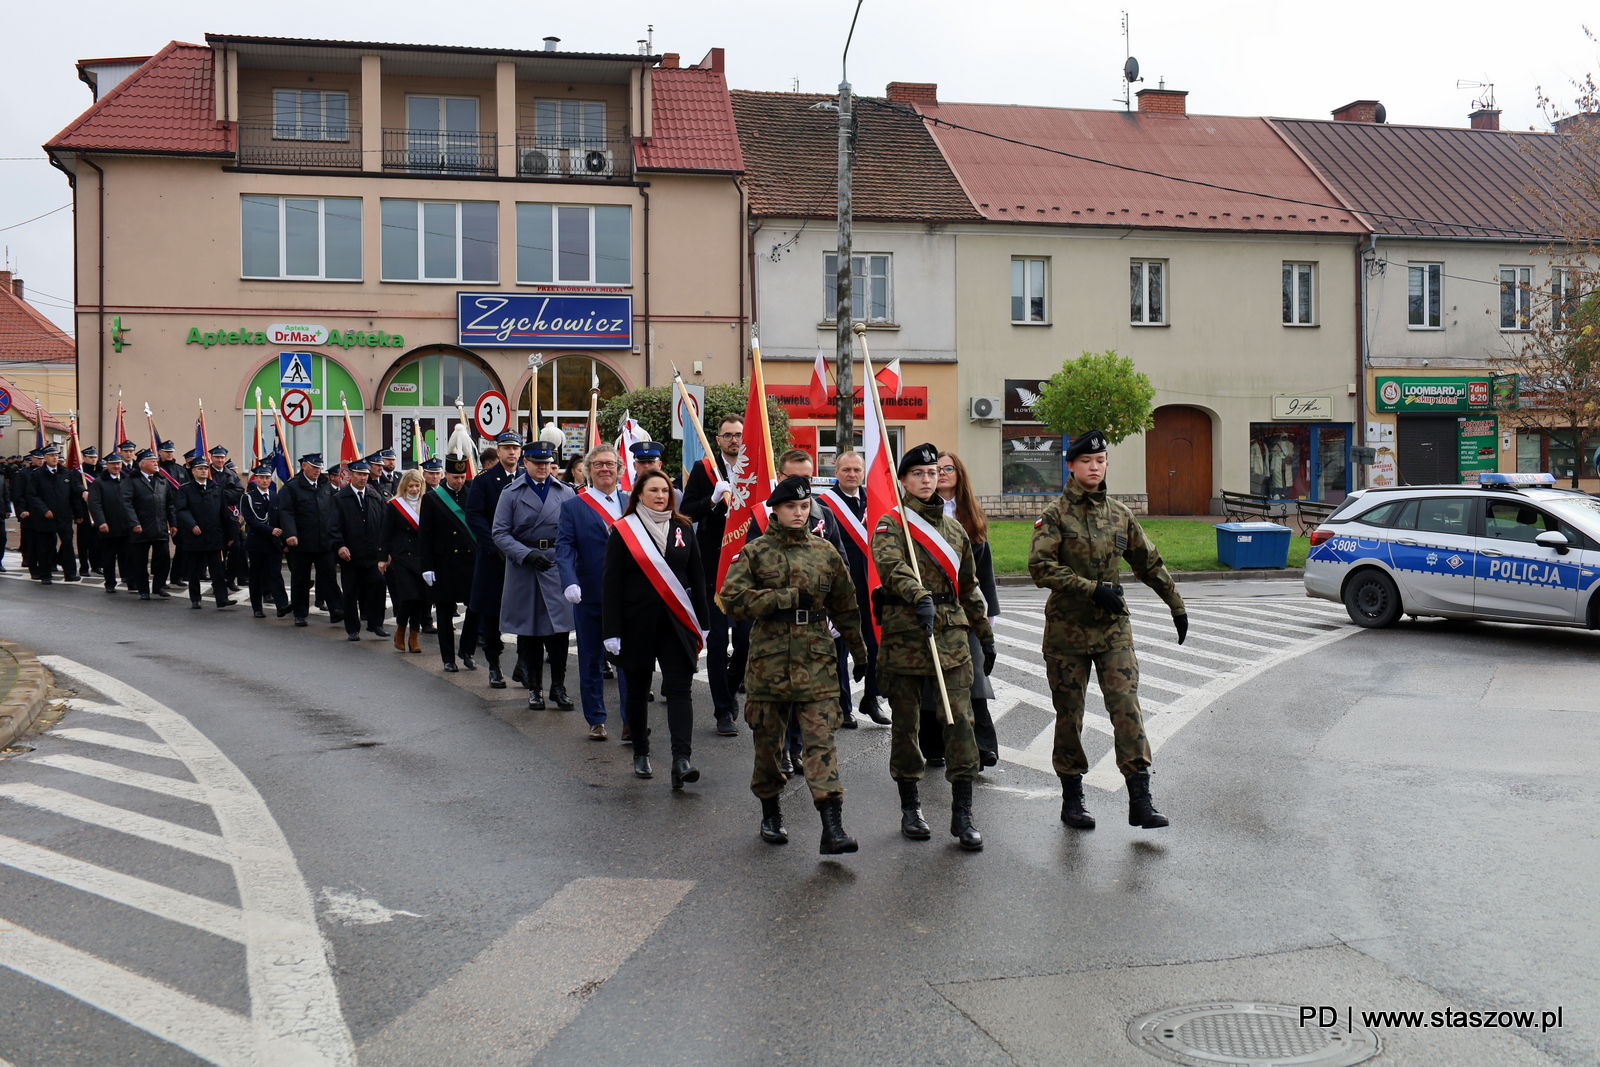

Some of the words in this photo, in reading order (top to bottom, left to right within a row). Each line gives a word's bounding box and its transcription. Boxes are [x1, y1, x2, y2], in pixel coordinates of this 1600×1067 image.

[466, 298, 624, 341] Zychowicz
[186, 327, 267, 348] Apteka
[275, 331, 317, 342] Dr.Max
[327, 329, 405, 349] Apteka
[1405, 386, 1465, 396] LOOMBARD.pl
[1470, 385, 1487, 393] 7dni
[1417, 395, 1436, 405] skup
[1436, 395, 1458, 404] złota!
[482, 402, 493, 425] 3
[497, 405, 500, 414] t
[1460, 420, 1494, 428] POŻYCZKI
[1331, 539, 1357, 552] S808
[1490, 560, 1561, 584] POLICJA
